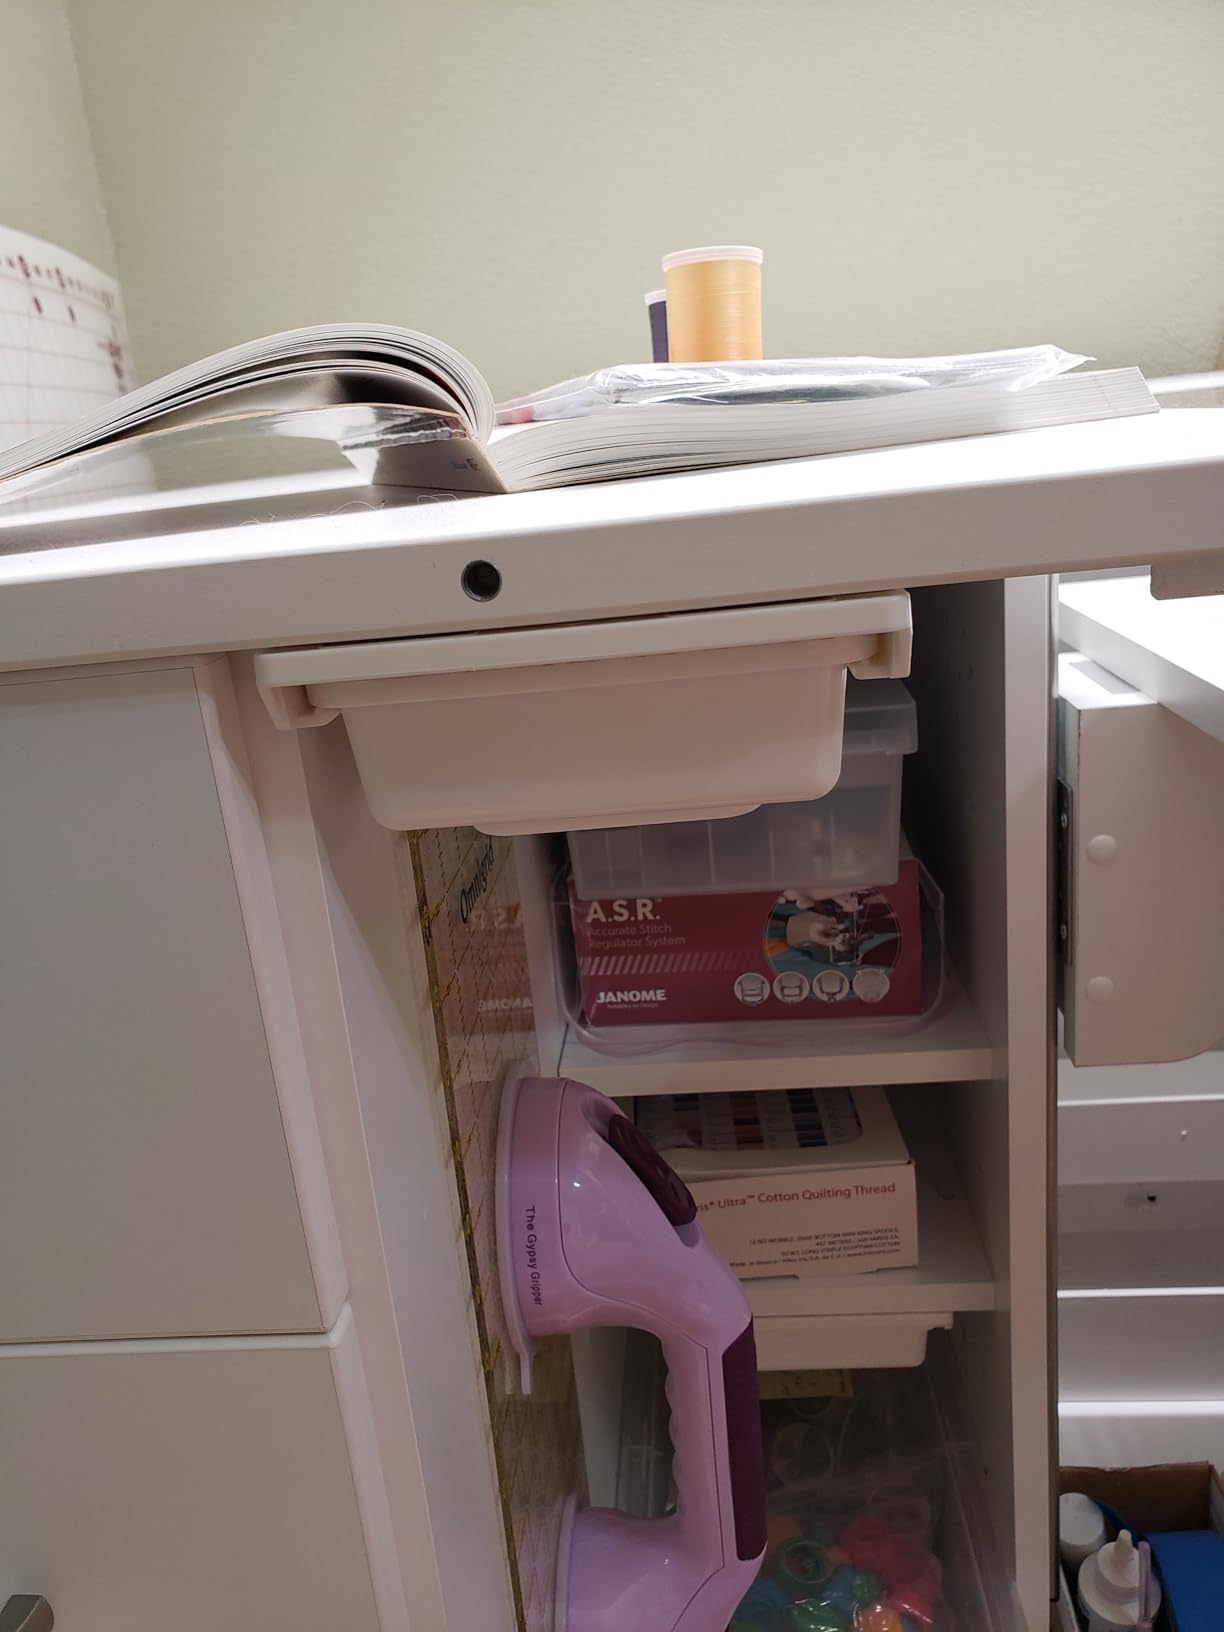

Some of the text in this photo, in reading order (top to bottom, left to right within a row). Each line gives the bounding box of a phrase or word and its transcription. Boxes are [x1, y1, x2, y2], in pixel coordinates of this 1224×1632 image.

[640, 923, 672, 935] Stitch
[645, 936, 686, 949] System
[596, 989, 667, 1003] JANOME
[757, 1192, 799, 1203] Cotton
[802, 1187, 851, 1202] Quilting
[852, 1182, 896, 1195] Thread
[525, 1205, 542, 1306] The Gypsy Gripper
